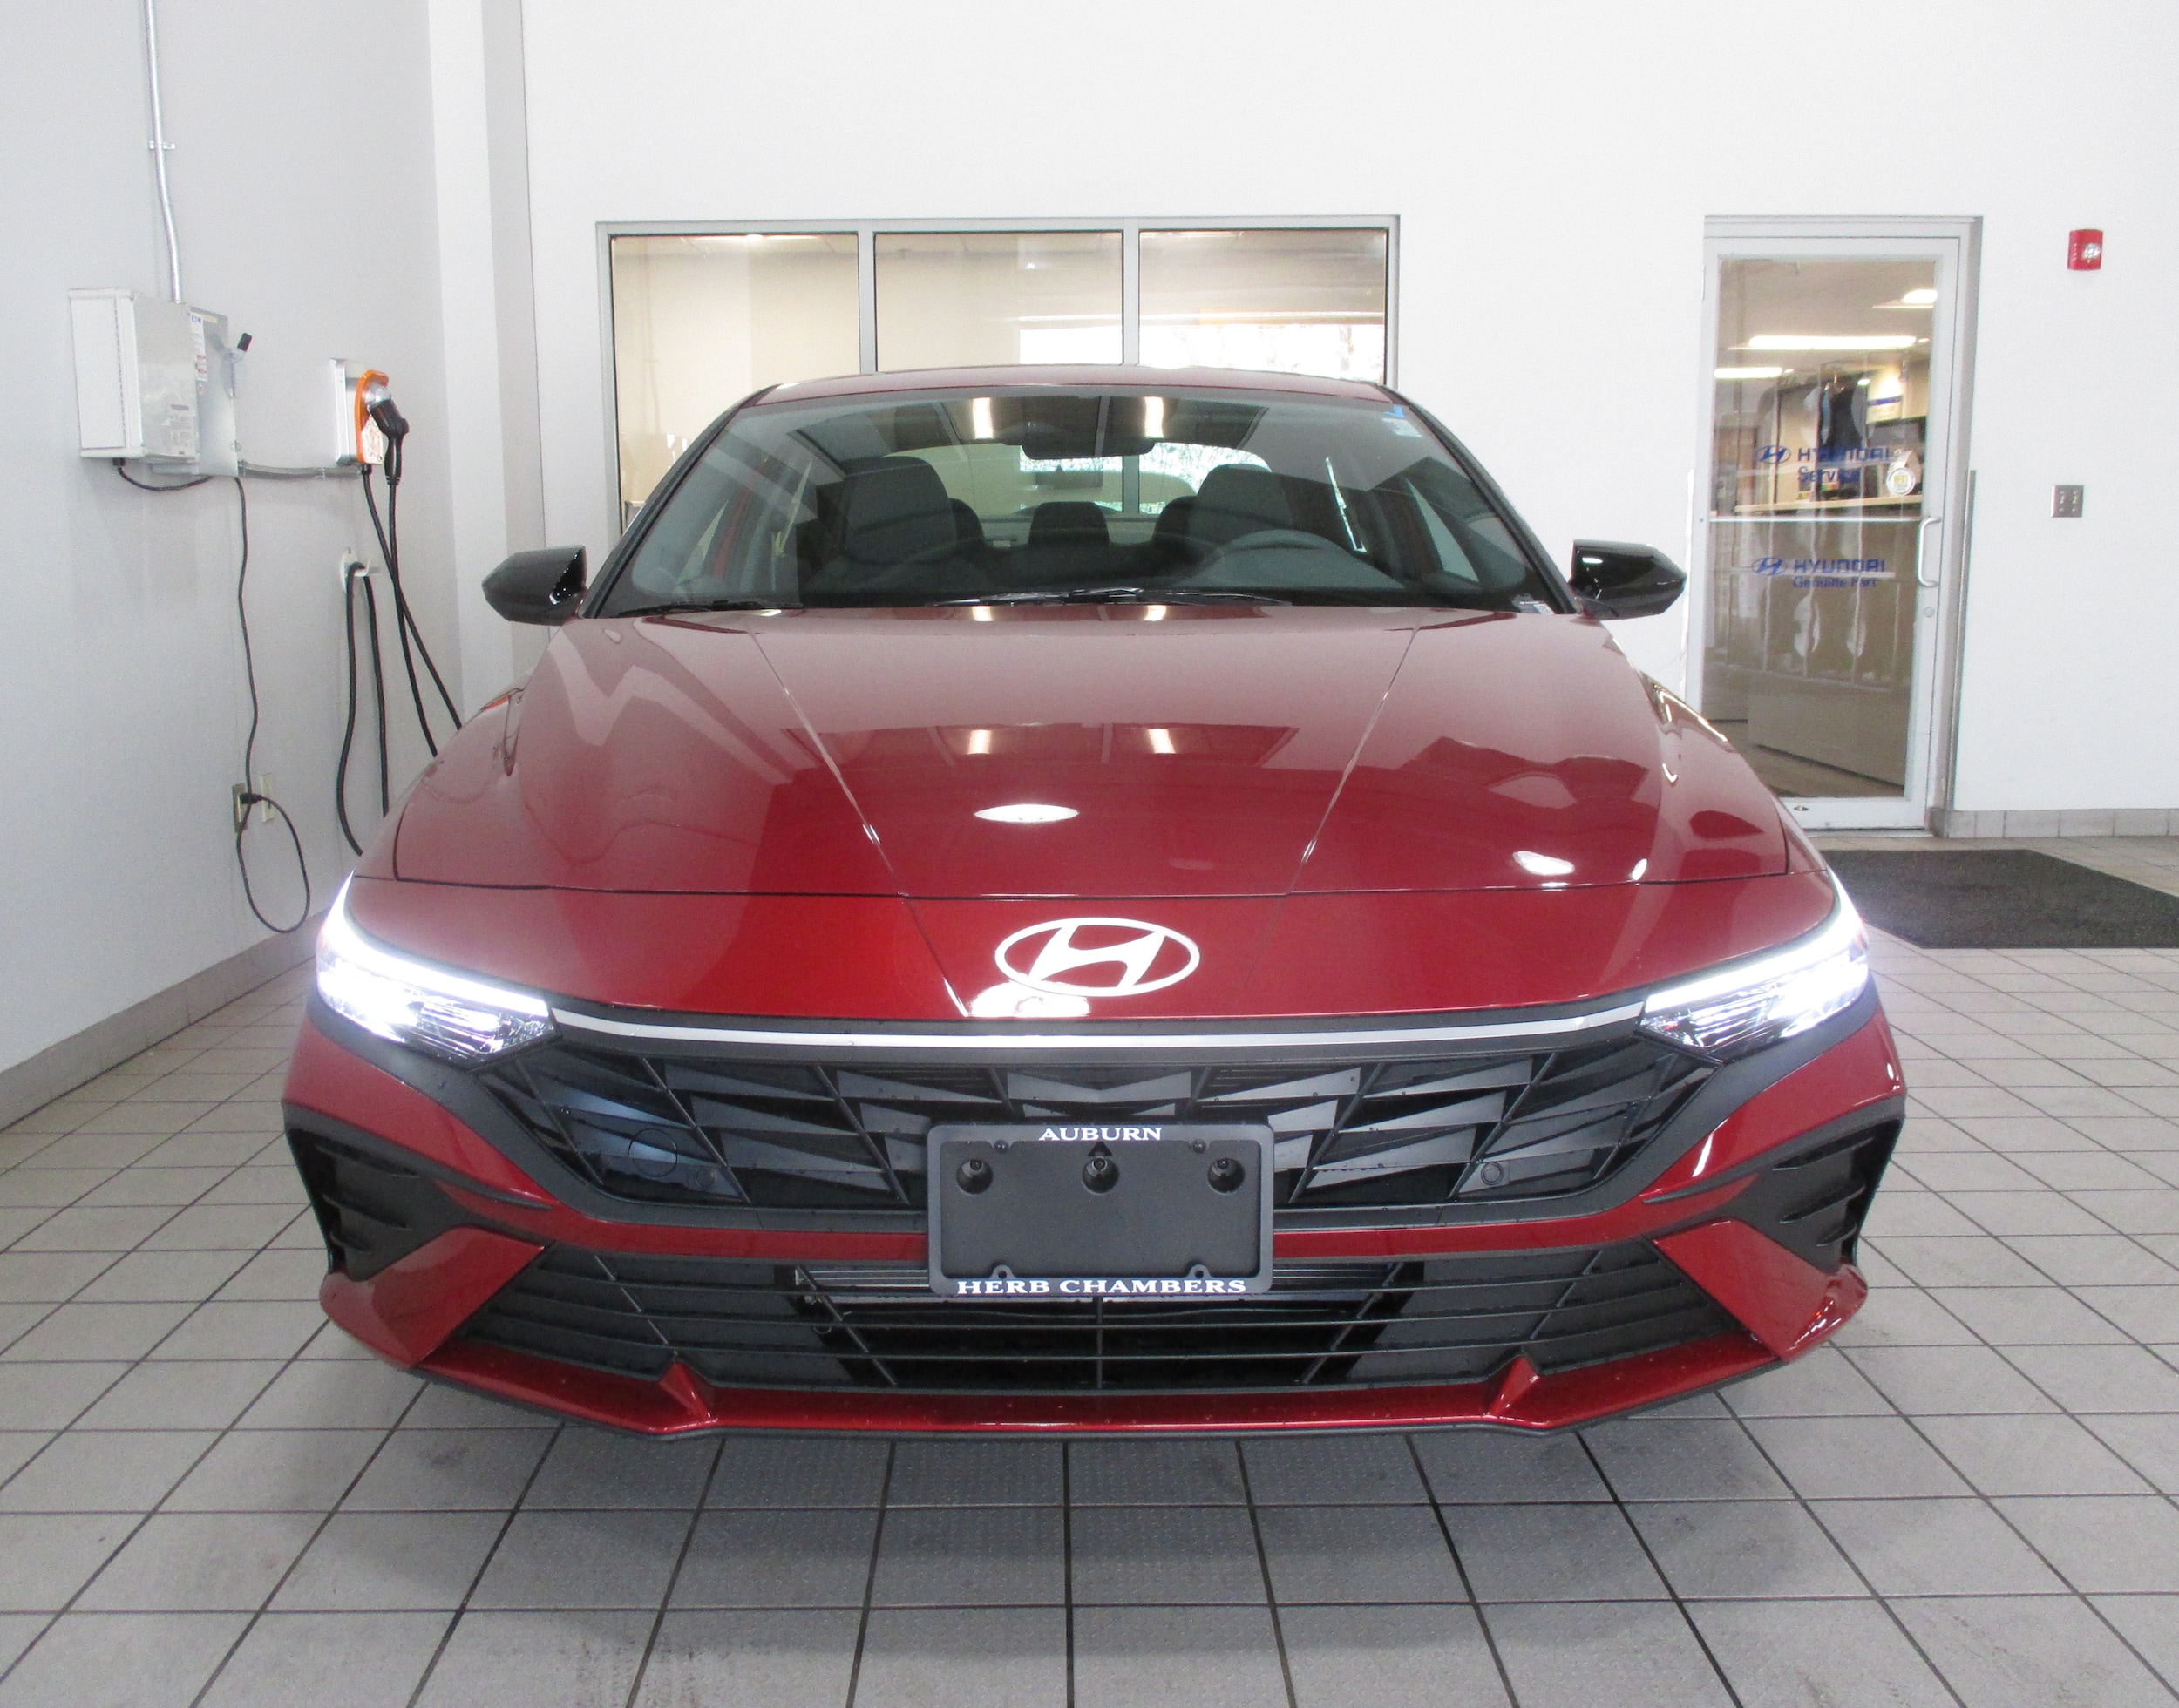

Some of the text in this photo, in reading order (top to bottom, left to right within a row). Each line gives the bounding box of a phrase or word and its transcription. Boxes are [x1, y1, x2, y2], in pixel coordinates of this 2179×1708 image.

[1794, 559, 1885, 573] HYUNDAI
[1038, 1127, 1162, 1142] AUBURN
[957, 1278, 1246, 1295] HERB CHAMBERS
